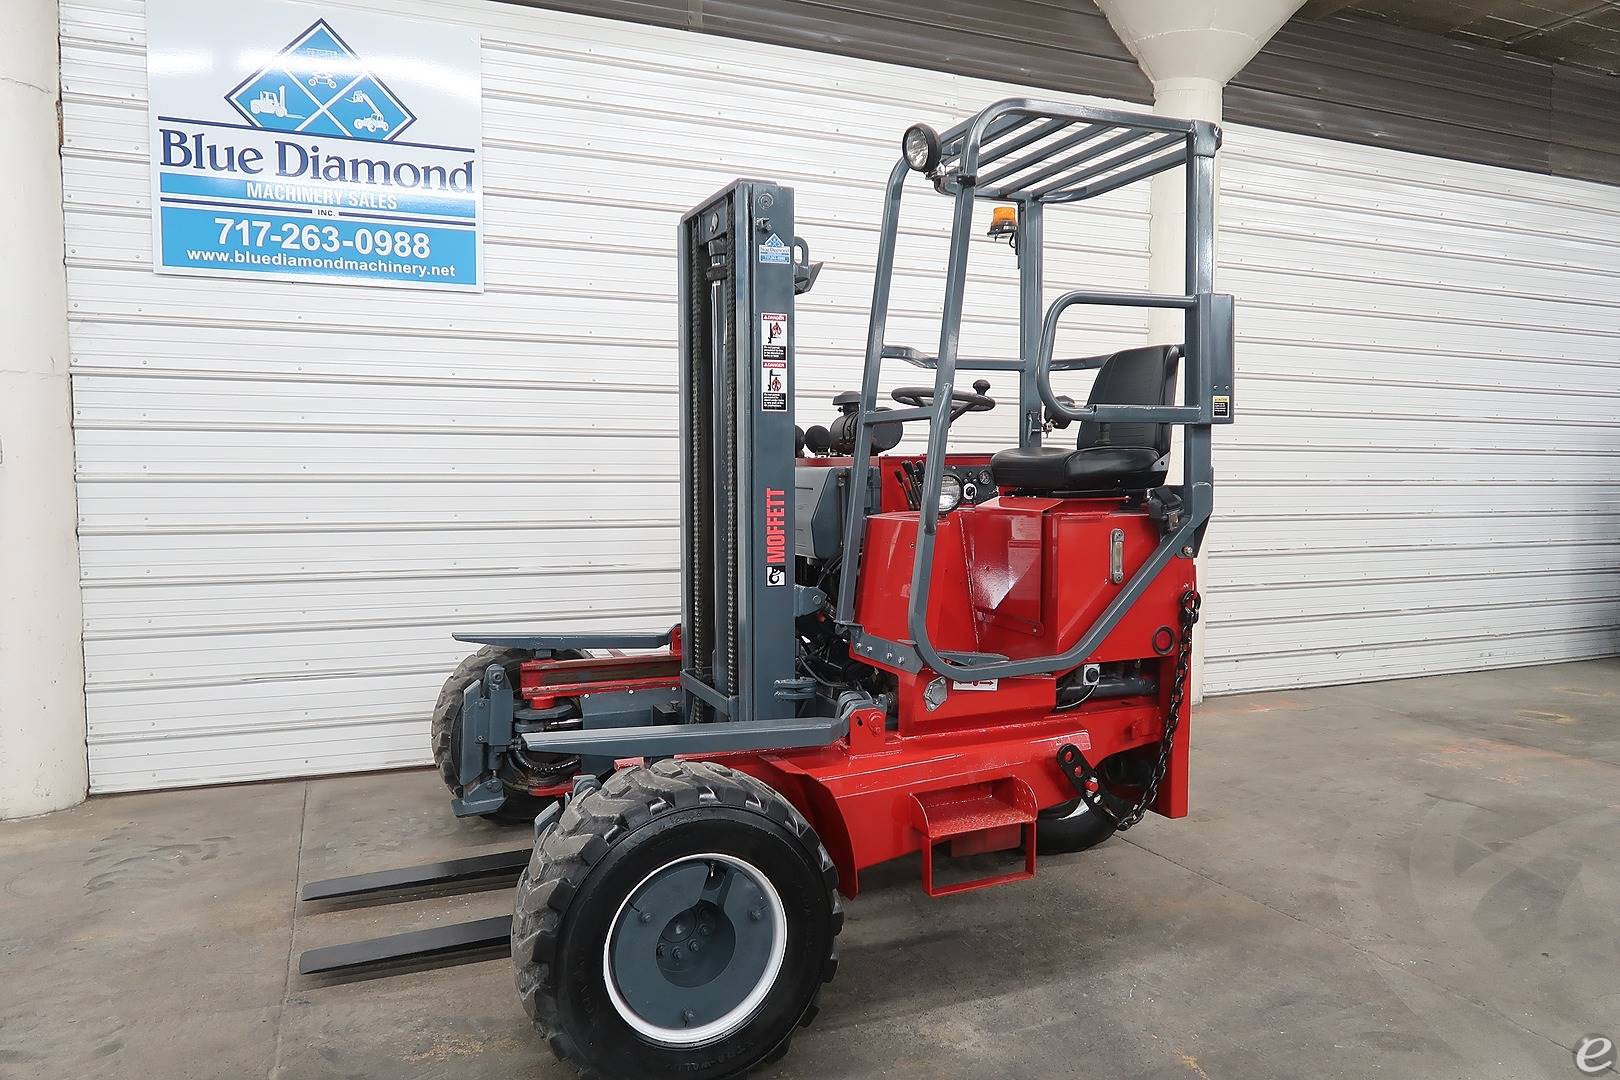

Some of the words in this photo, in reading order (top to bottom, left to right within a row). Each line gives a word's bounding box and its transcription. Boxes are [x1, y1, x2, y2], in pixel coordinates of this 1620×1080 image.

[159, 128, 264, 174] Blue
[274, 140, 475, 193] Diamond
[246, 182, 343, 206] MACHINERY
[348, 190, 398, 209] SALES
[317, 209, 336, 217] INC.
[214, 217, 431, 259] 717-263-0988
[186, 249, 456, 277] www.bluediamondmachinery.net
[766, 487, 785, 564] MOFFETT
